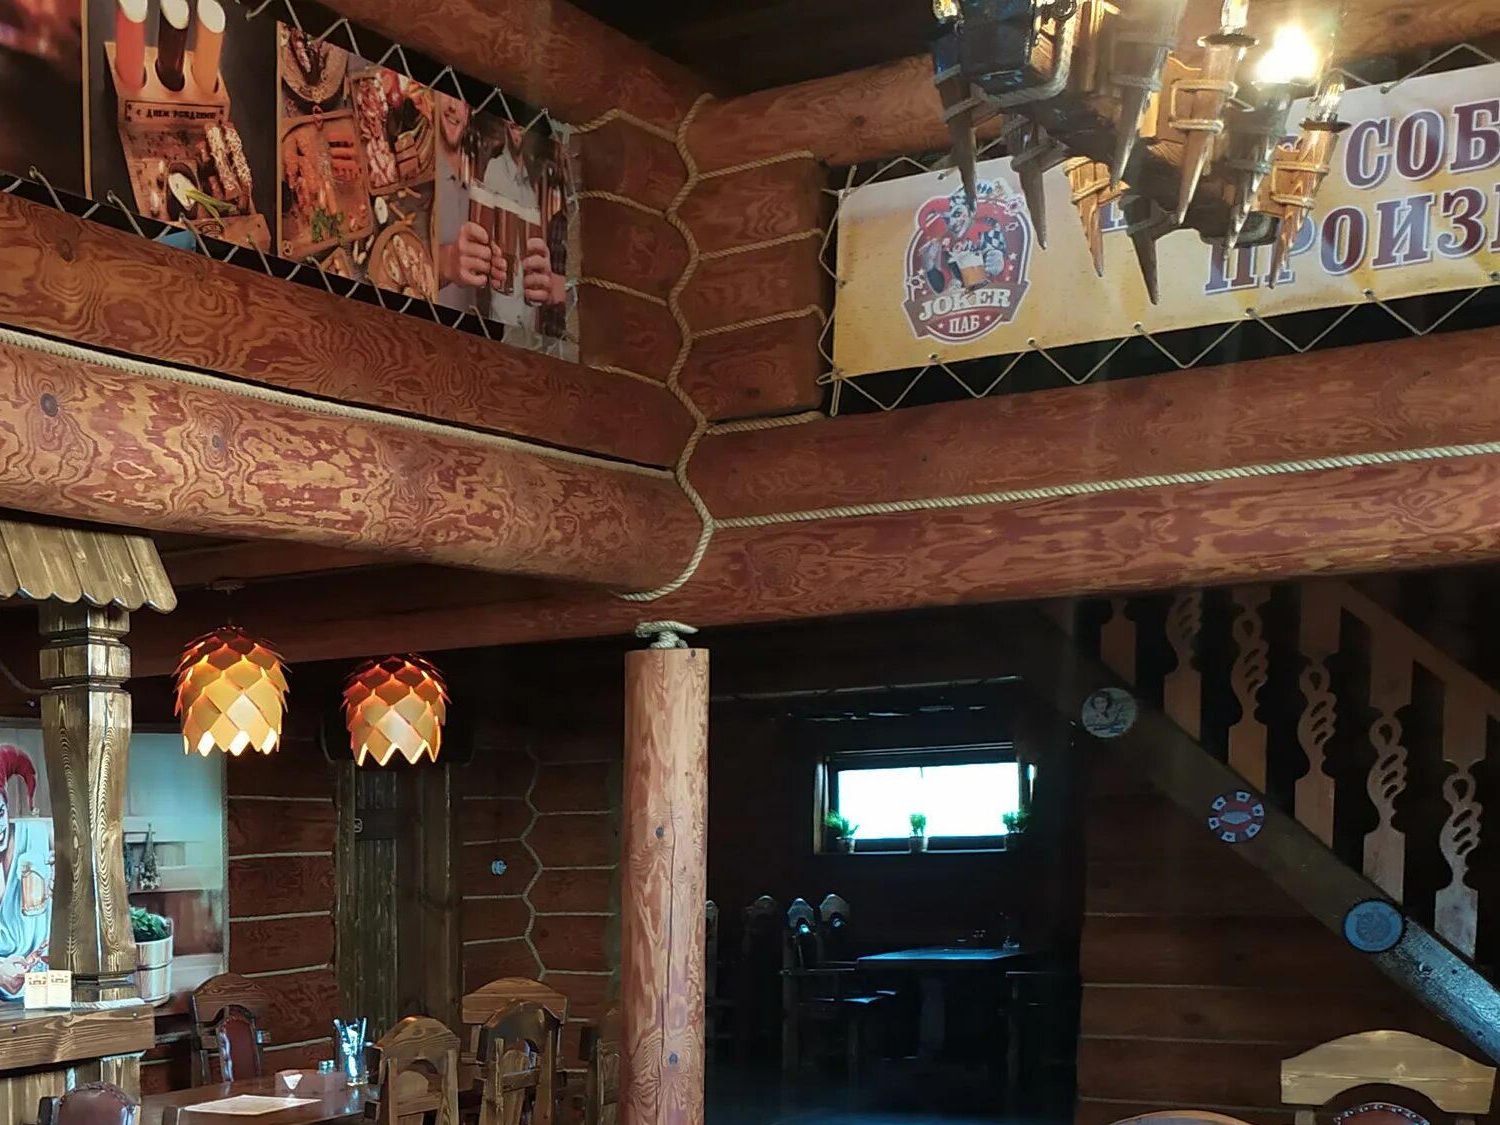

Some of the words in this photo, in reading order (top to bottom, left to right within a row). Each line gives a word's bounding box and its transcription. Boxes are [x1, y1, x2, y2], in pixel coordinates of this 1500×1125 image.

[1204, 182, 1500, 294] ПРОИЗ
[918, 288, 1011, 321] JOKER
[948, 314, 980, 334] ПАБ
